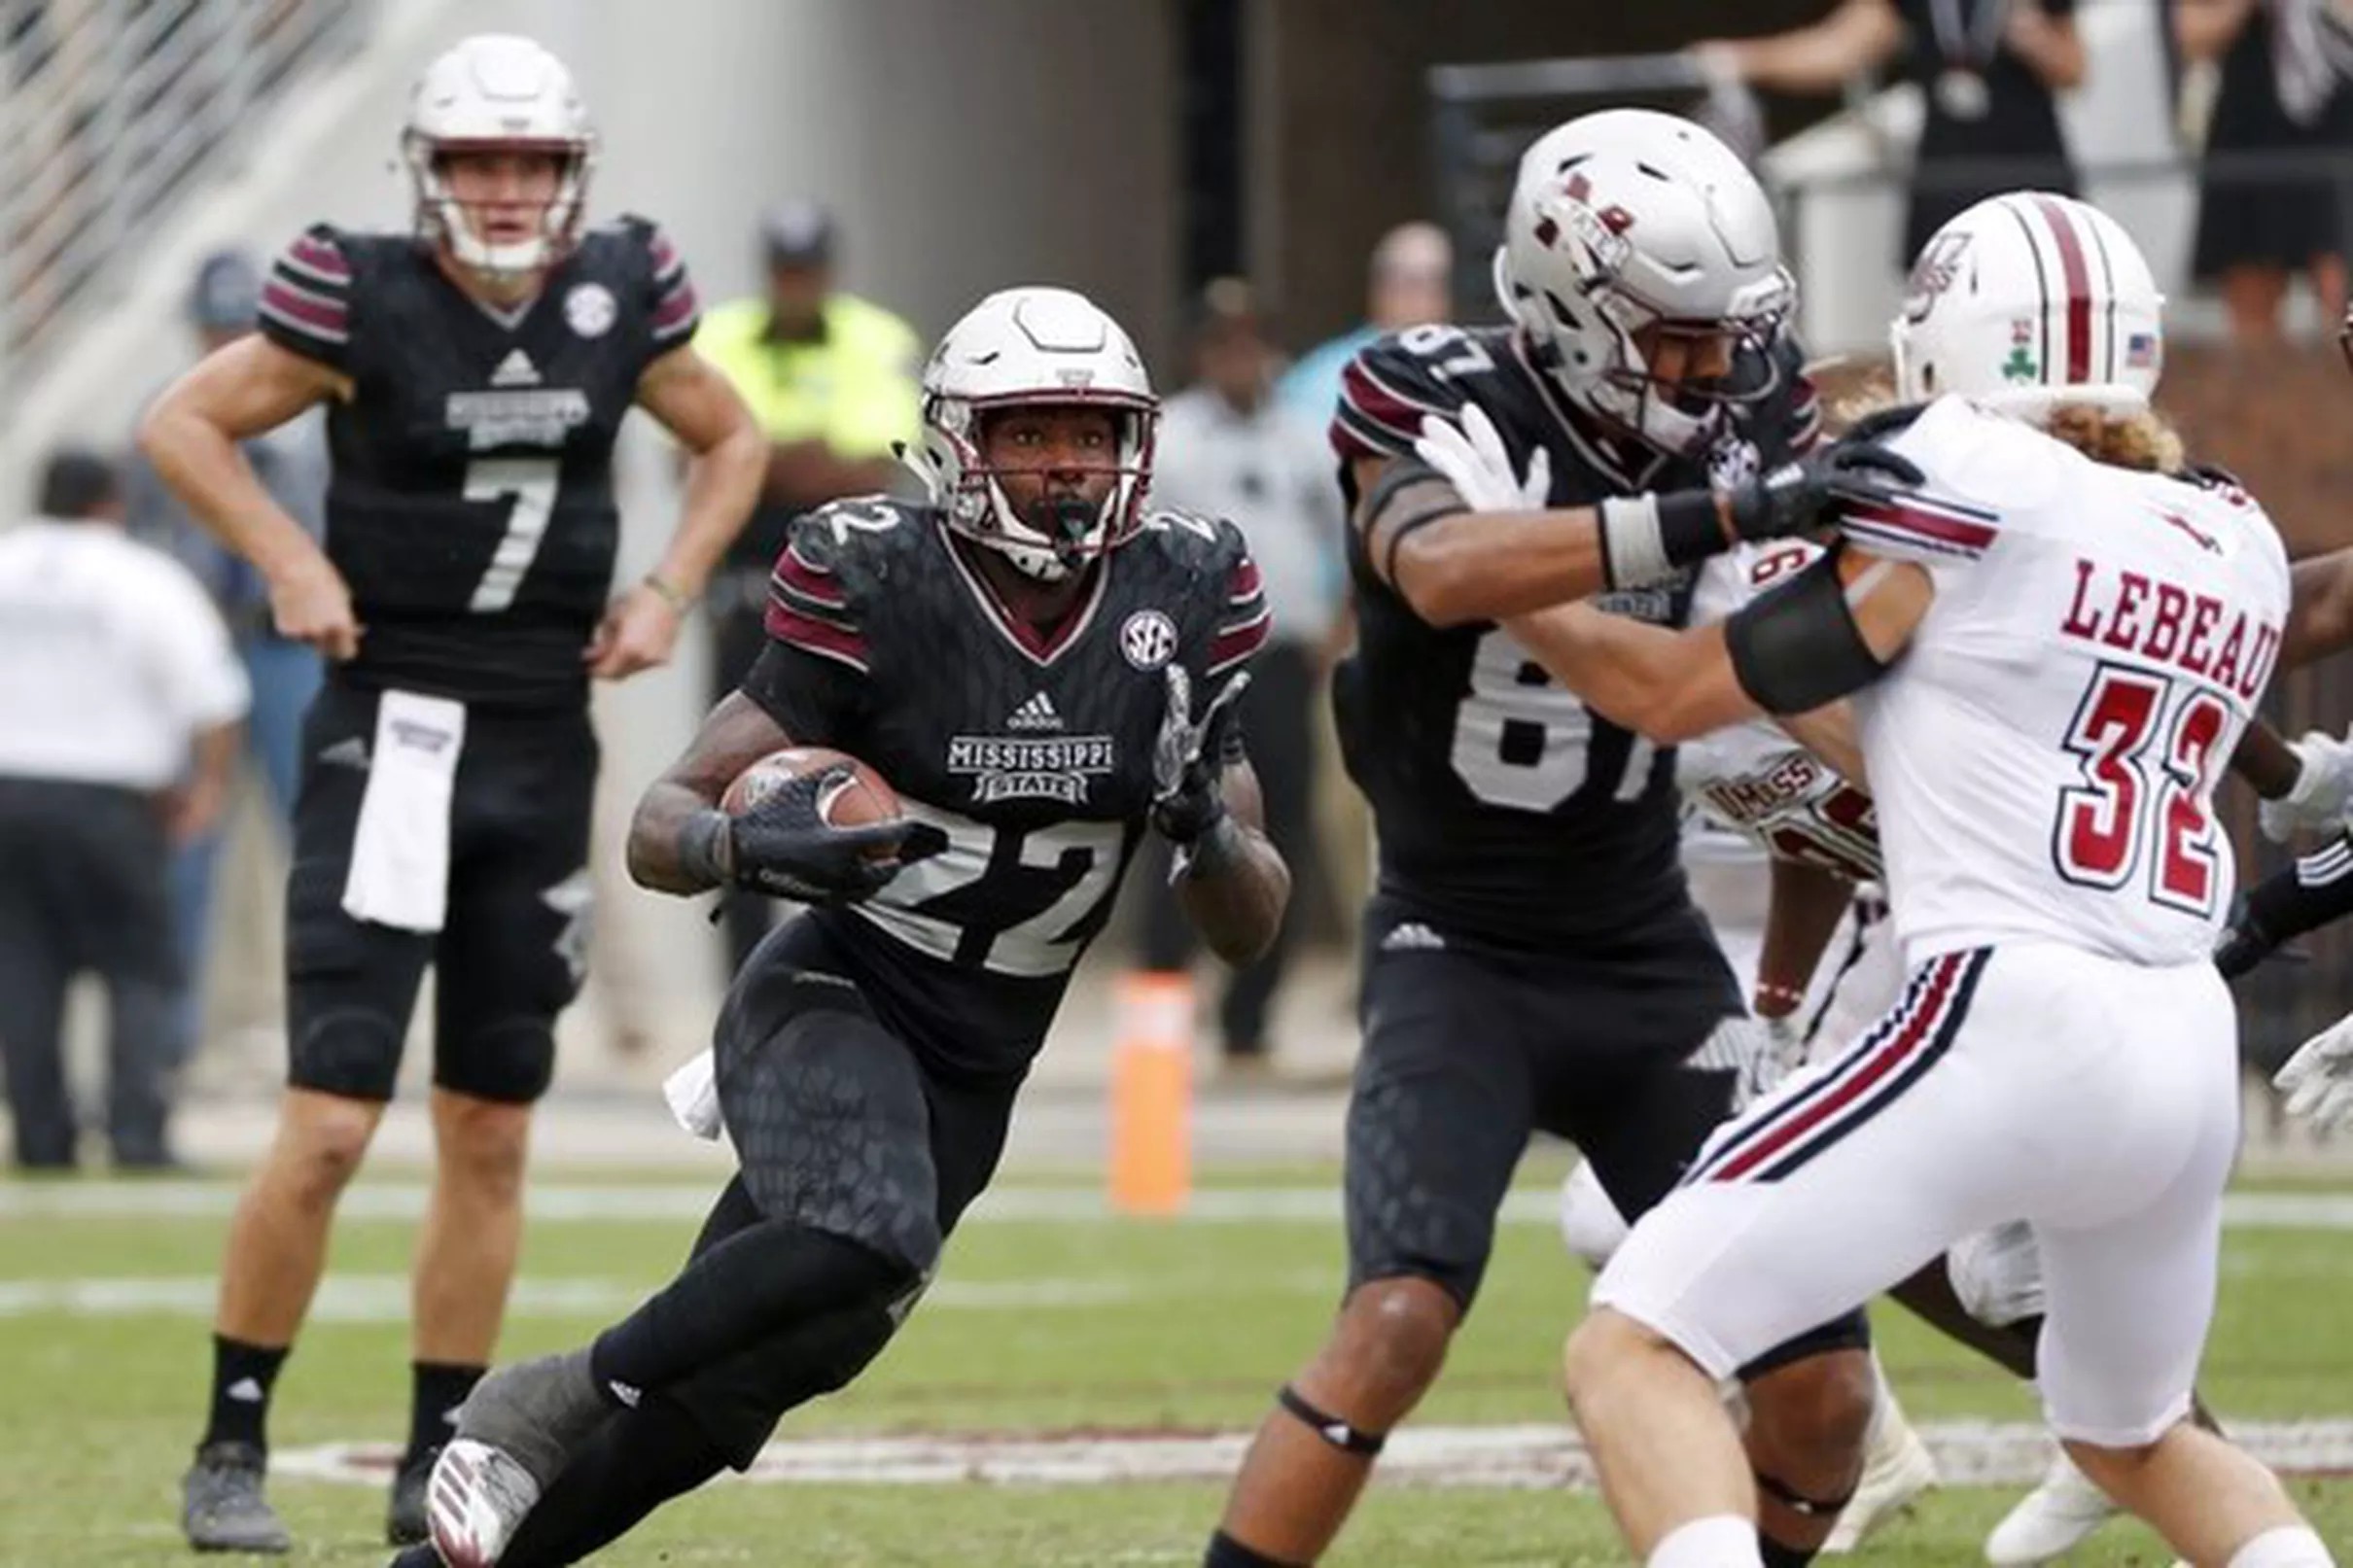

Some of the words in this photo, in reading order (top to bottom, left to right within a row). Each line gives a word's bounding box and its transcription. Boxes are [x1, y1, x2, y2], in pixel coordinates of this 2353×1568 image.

[462, 458, 561, 613] 7
[2060, 558, 2280, 700] LEBEAU
[947, 741, 1113, 770] MISSISSIPPI
[986, 773, 1077, 801] STATE
[2051, 658, 2237, 921] 32
[847, 792, 1125, 978] 22
